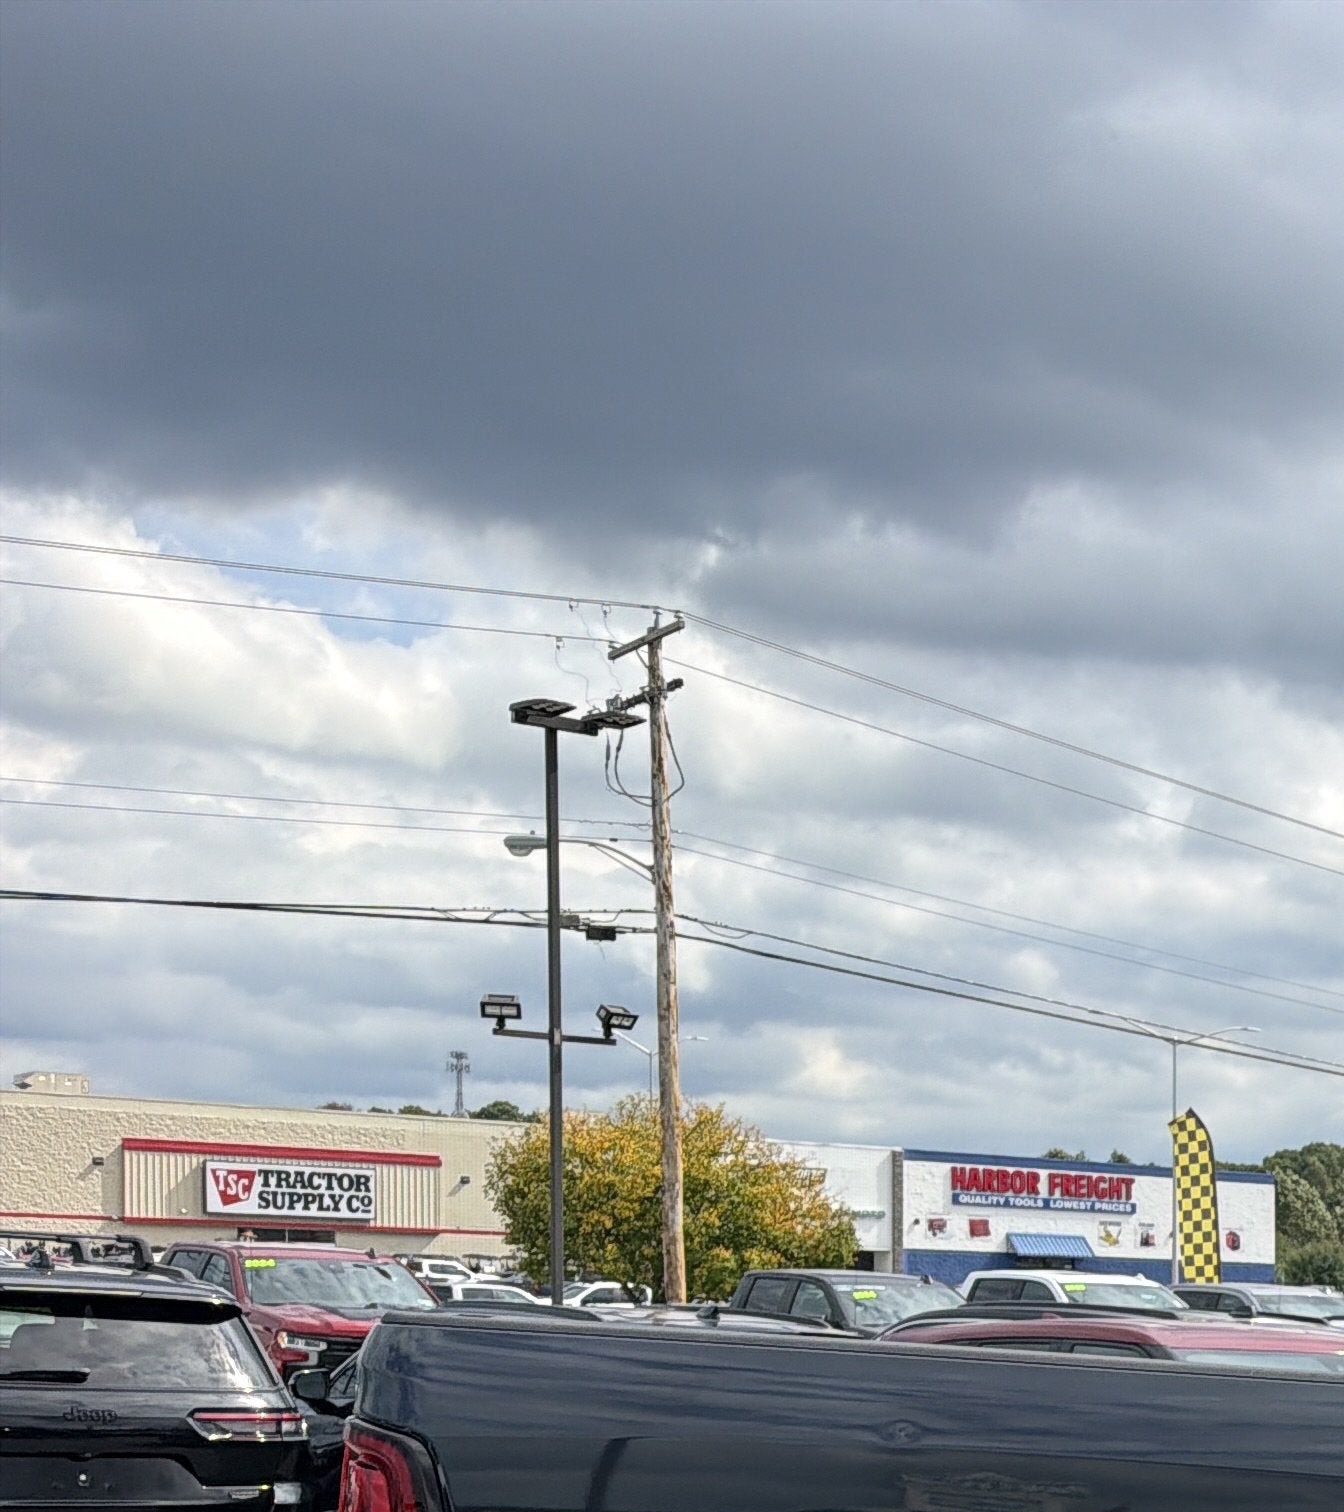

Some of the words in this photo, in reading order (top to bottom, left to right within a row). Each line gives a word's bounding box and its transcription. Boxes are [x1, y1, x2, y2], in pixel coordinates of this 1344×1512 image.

[215, 1170, 249, 1200] TSC
[257, 1169, 371, 1193] TRACTOR
[951, 1166, 1041, 1197] HARBOR
[1048, 1172, 1136, 1202] FREIGHT
[257, 1190, 345, 1213] SUPPLY
[959, 1194, 1007, 1206] QUALITY
[1008, 1197, 1044, 1208] TOOLS
[1050, 1200, 1092, 1211] LOWEST
[1094, 1203, 1133, 1213] PRICES
[62, 1406, 118, 1424] Jeep
